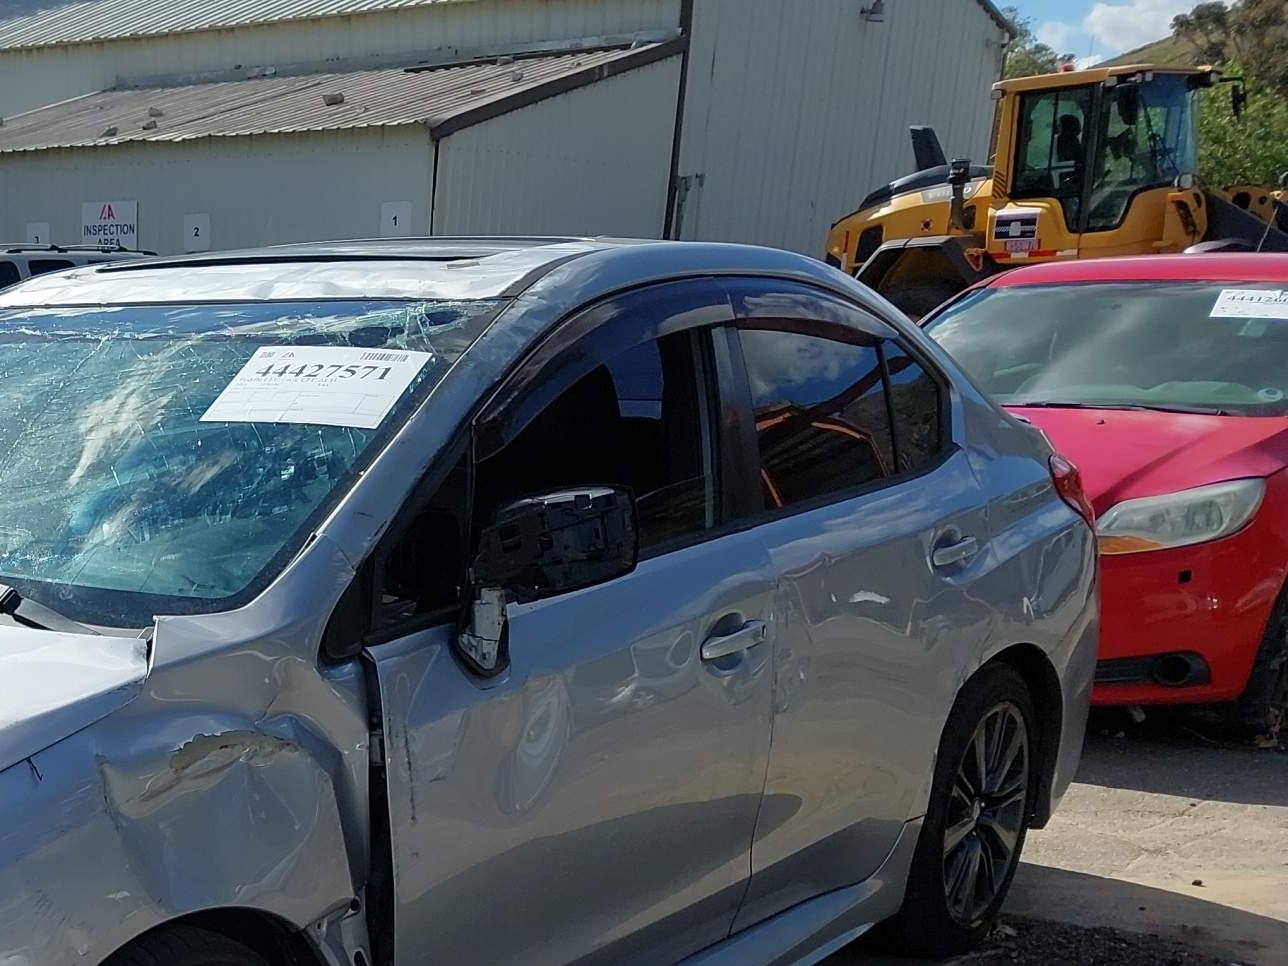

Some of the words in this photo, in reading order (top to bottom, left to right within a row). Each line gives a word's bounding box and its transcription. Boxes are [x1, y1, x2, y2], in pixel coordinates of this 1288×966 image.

[392, 215, 398, 226] 1
[83, 224, 135, 236] INSPECTION
[193, 227, 200, 237] 2
[256, 363, 393, 380] 44427571
